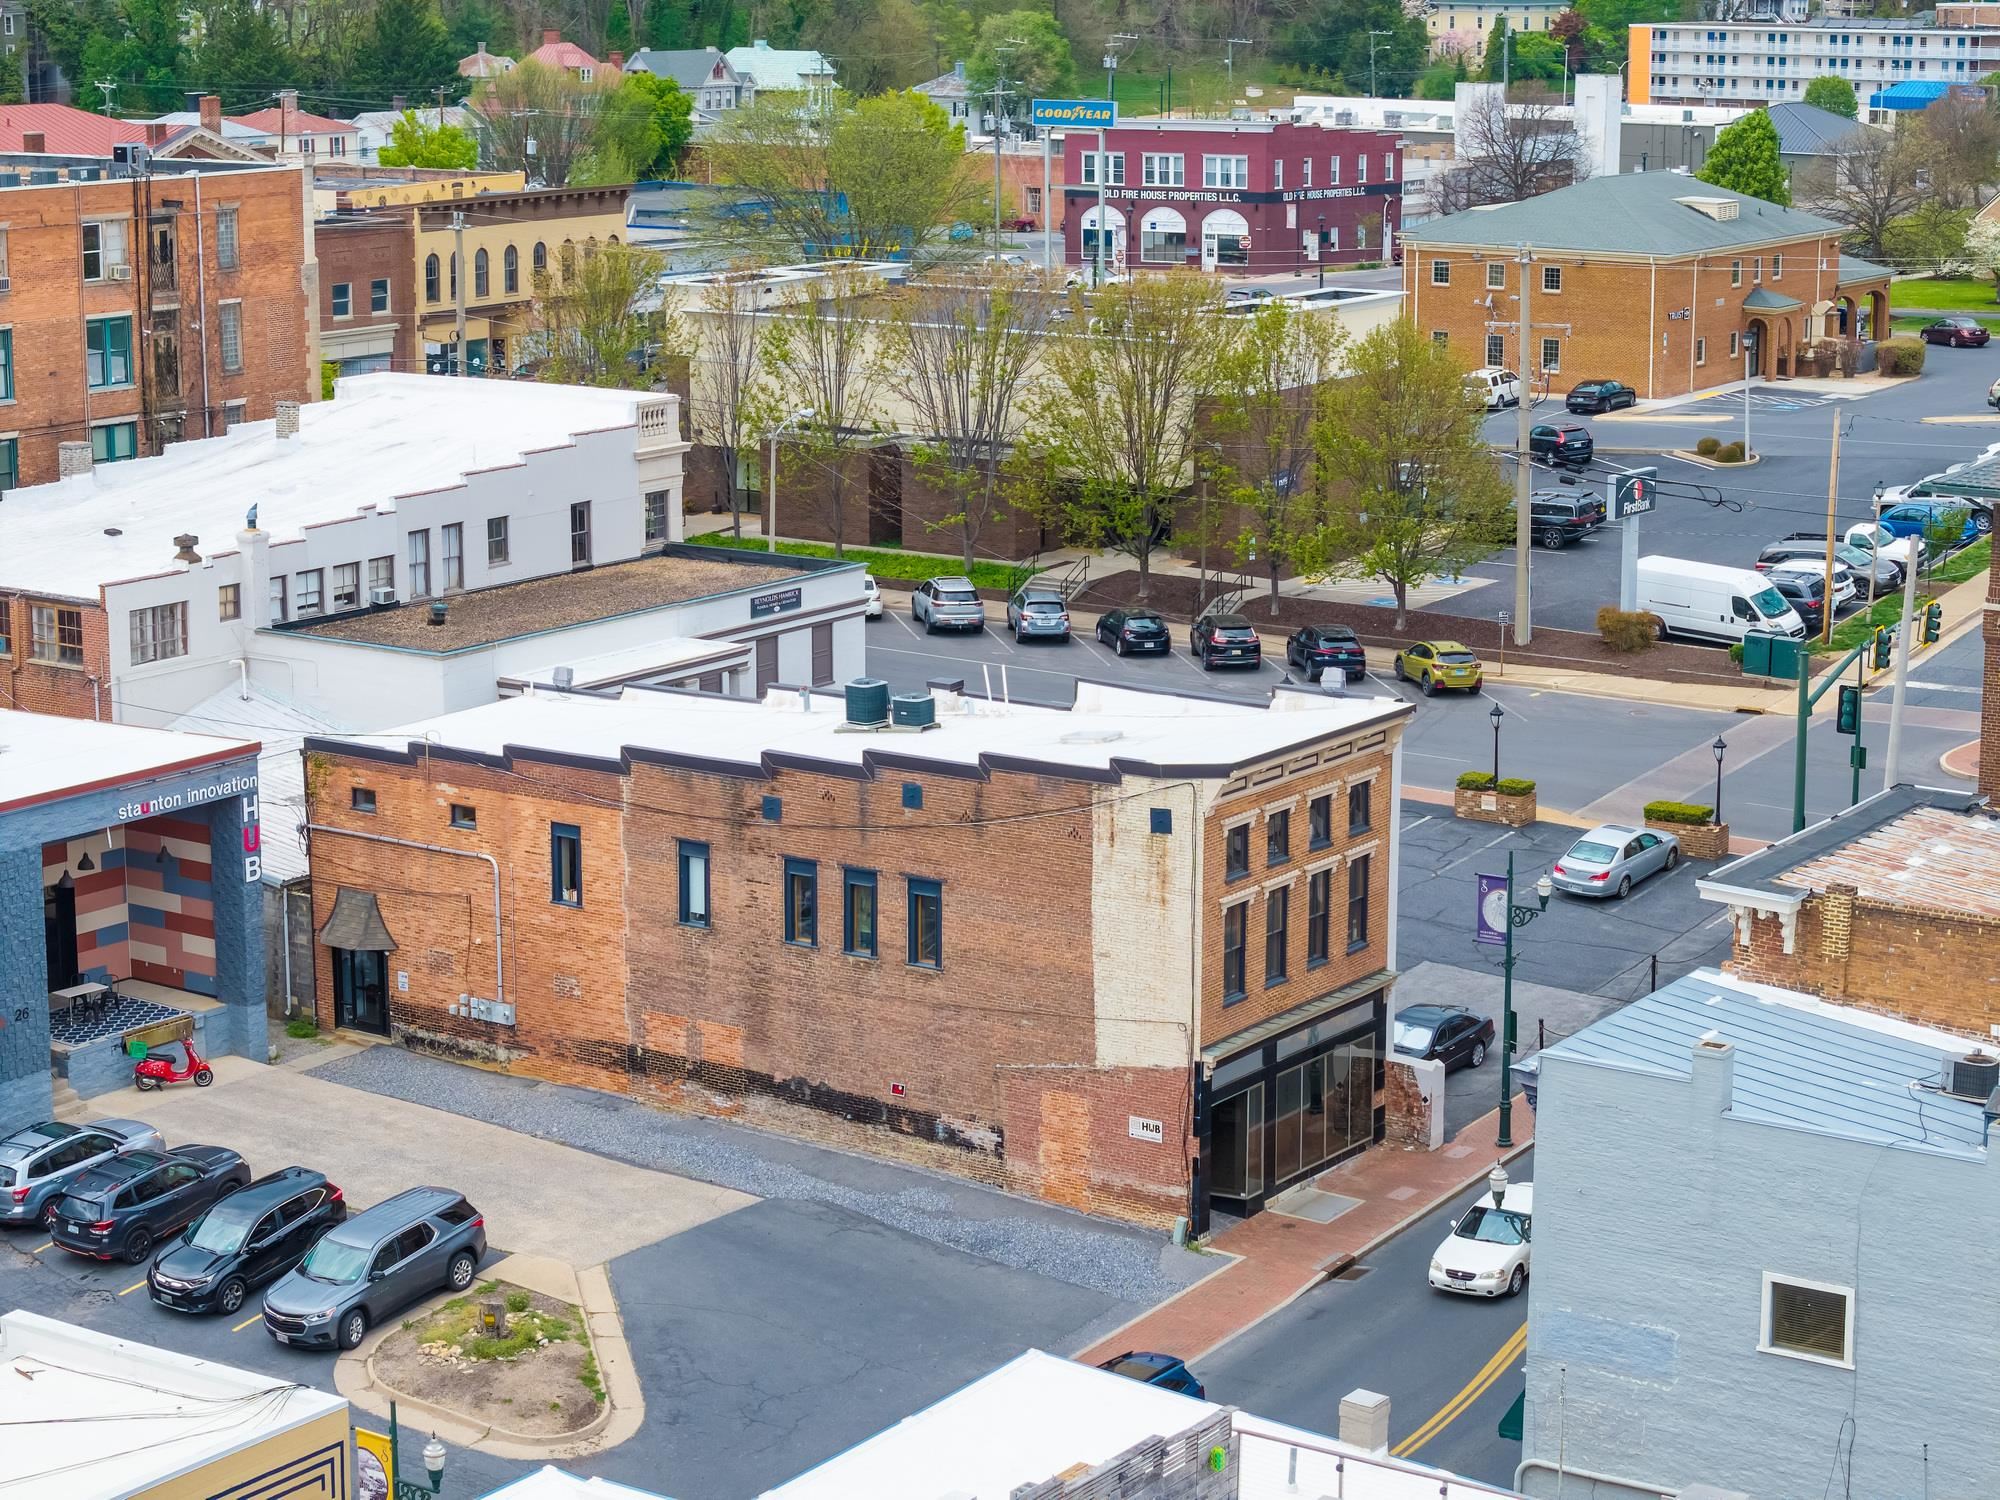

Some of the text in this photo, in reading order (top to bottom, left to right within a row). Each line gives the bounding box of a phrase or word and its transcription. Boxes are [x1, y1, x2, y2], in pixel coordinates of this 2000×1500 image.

[1036, 107, 1111, 120] GOODYEAR
[1104, 189, 1242, 203] OLD FIRE HOUSE PROPERTIES L.L.C.
[1283, 191, 1293, 201] OLD
[1306, 189, 1323, 200] HOUSE
[1323, 187, 1352, 199] PROPERTIES
[1623, 498, 1650, 514] FirstBank
[118, 776, 257, 820] staunton innovation
[242, 794, 262, 883] HUB
[15, 1007, 29, 1022] 26
[1141, 1121, 1161, 1134] HUB
